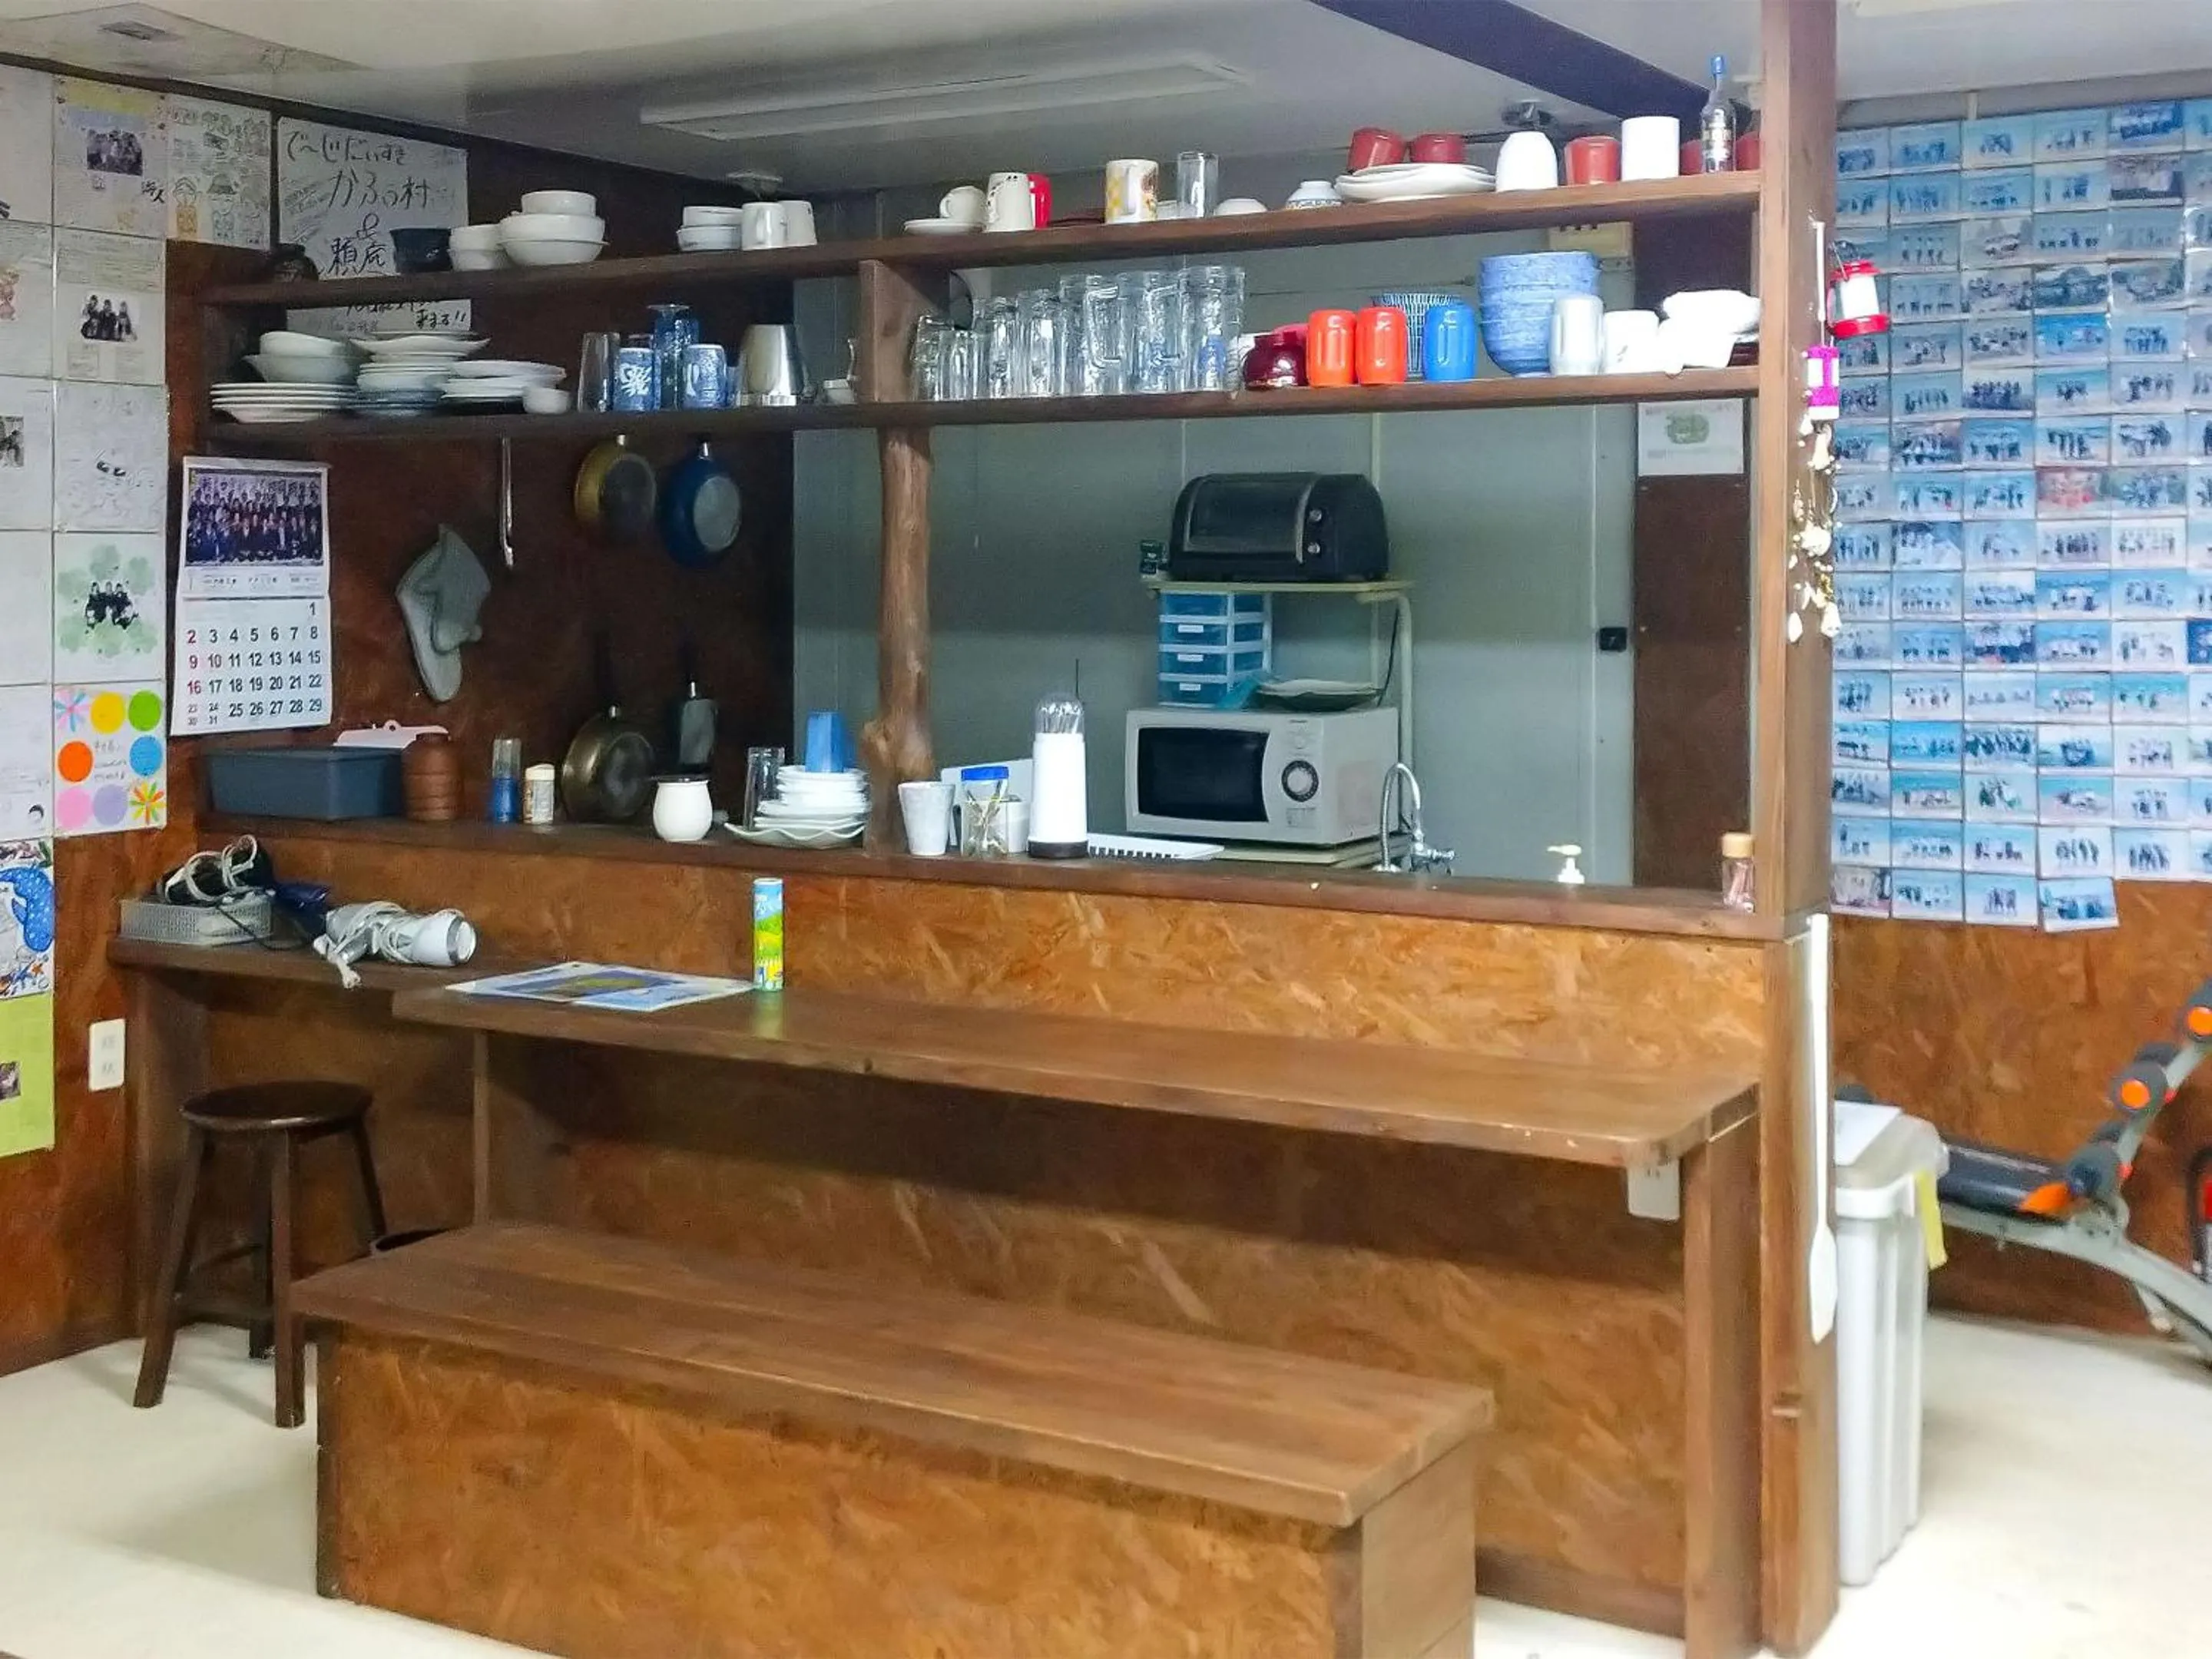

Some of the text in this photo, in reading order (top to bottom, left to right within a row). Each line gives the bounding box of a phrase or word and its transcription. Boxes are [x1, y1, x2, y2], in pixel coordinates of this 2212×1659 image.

[310, 601, 316, 615] 1
[187, 626, 318, 644] 2 3 4 5 6 7 8
[189, 650, 320, 669] 9 10 11 12 13 14 15
[187, 674, 322, 694] 16 17 18 19 20 21 22
[229, 704, 243, 717] 25
[250, 702, 263, 716] 26
[270, 700, 283, 715] 27
[290, 699, 303, 713] 28
[310, 699, 322, 711] 29
